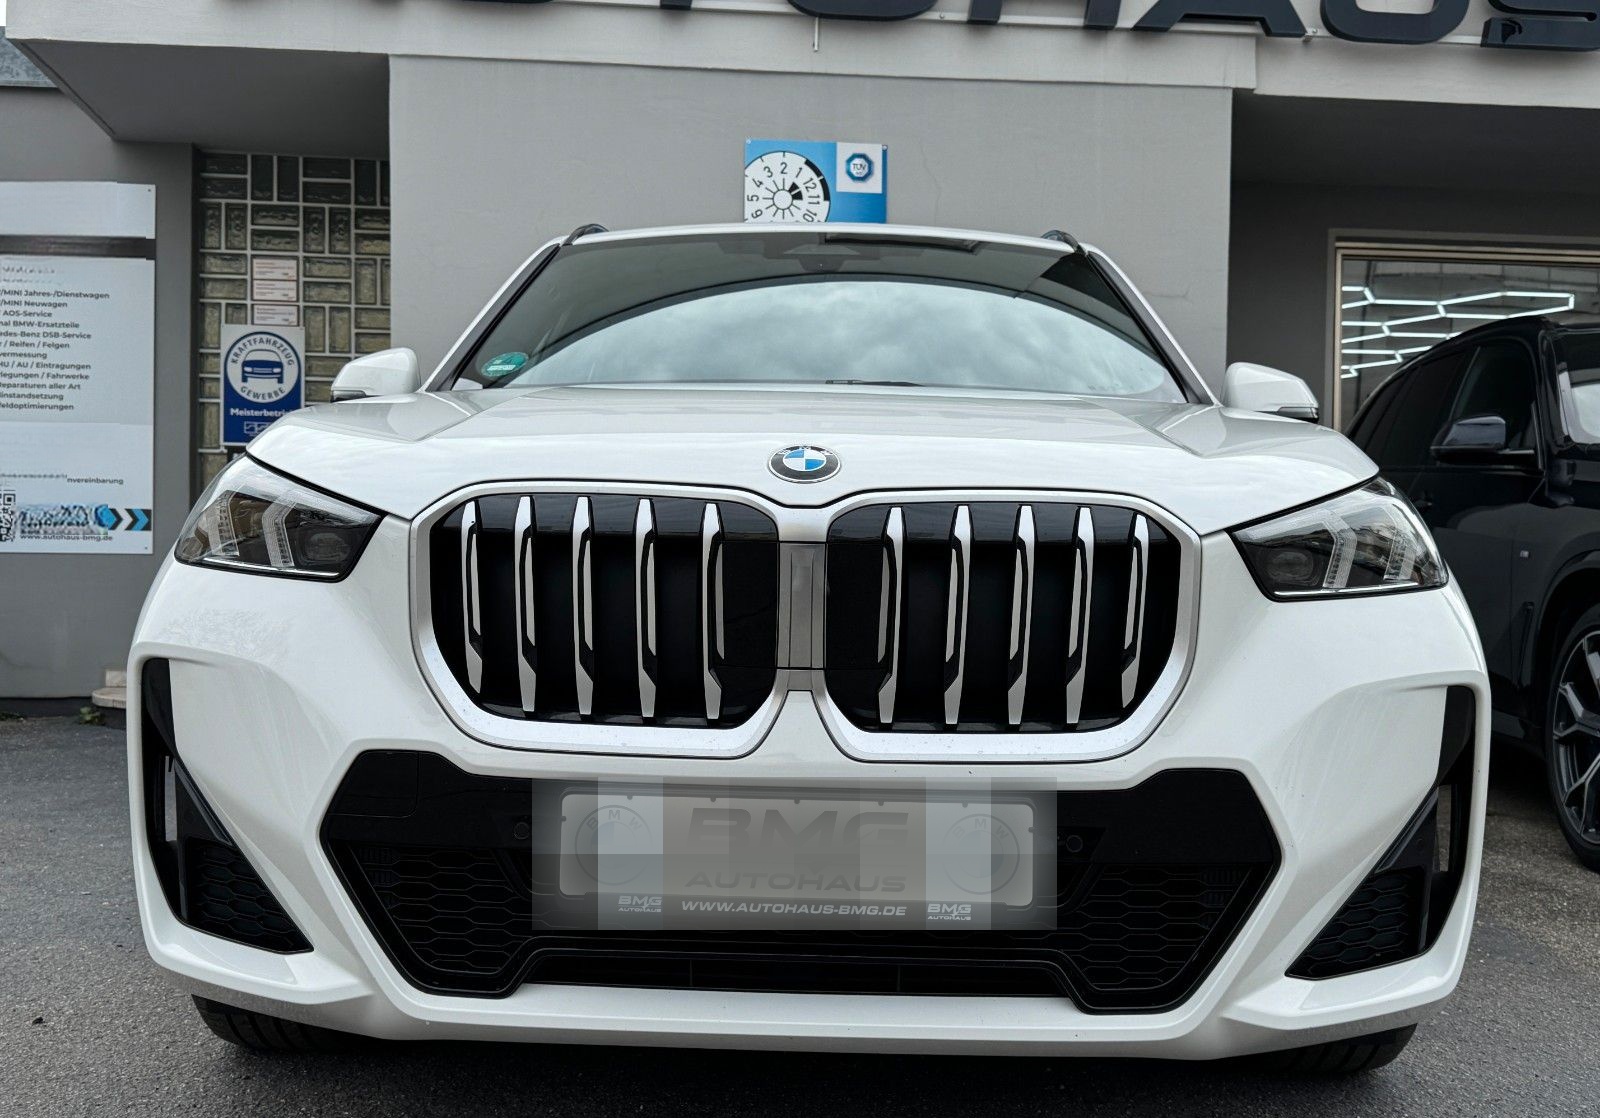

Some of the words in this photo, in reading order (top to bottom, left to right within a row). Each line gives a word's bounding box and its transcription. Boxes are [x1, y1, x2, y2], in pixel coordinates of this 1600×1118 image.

[764, 166, 773, 178] 3
[780, 162, 788, 174] 2
[795, 167, 803, 178] 1
[752, 178, 764, 188] 4
[803, 178, 817, 192] 12
[747, 194, 759, 202] 5
[807, 194, 820, 206] 11
[0, 288, 22, 297] /MINI
[24, 290, 110, 299] Jahres-/Dienstwagen
[0, 299, 22, 307] /MINI
[24, 300, 68, 309] Neuwagen
[3, 310, 53, 318] AOS-Service
[13, 320, 80, 329] BMW-Ersatzteile
[42, 331, 92, 339] DSB-Service
[9, 340, 35, 348] Reifen
[42, 341, 70, 350] Felgen
[231, 337, 295, 366] KRAFTFAHRZEUG
[16, 361, 29, 369] AU
[36, 362, 91, 371] Eintragungen
[46, 372, 90, 381] Fahrwerke
[240, 386, 286, 400] GEWERBE
[230, 407, 288, 417] Meisterbetri
[586, 809, 643, 831] BMW
[952, 818, 1010, 840] BMW
[685, 872, 907, 892] AUTOHAUS
[618, 895, 662, 907] BMG
[682, 900, 907, 916] WWW.AUTOHAUS-BMG.DE
[927, 904, 972, 915] BMG
